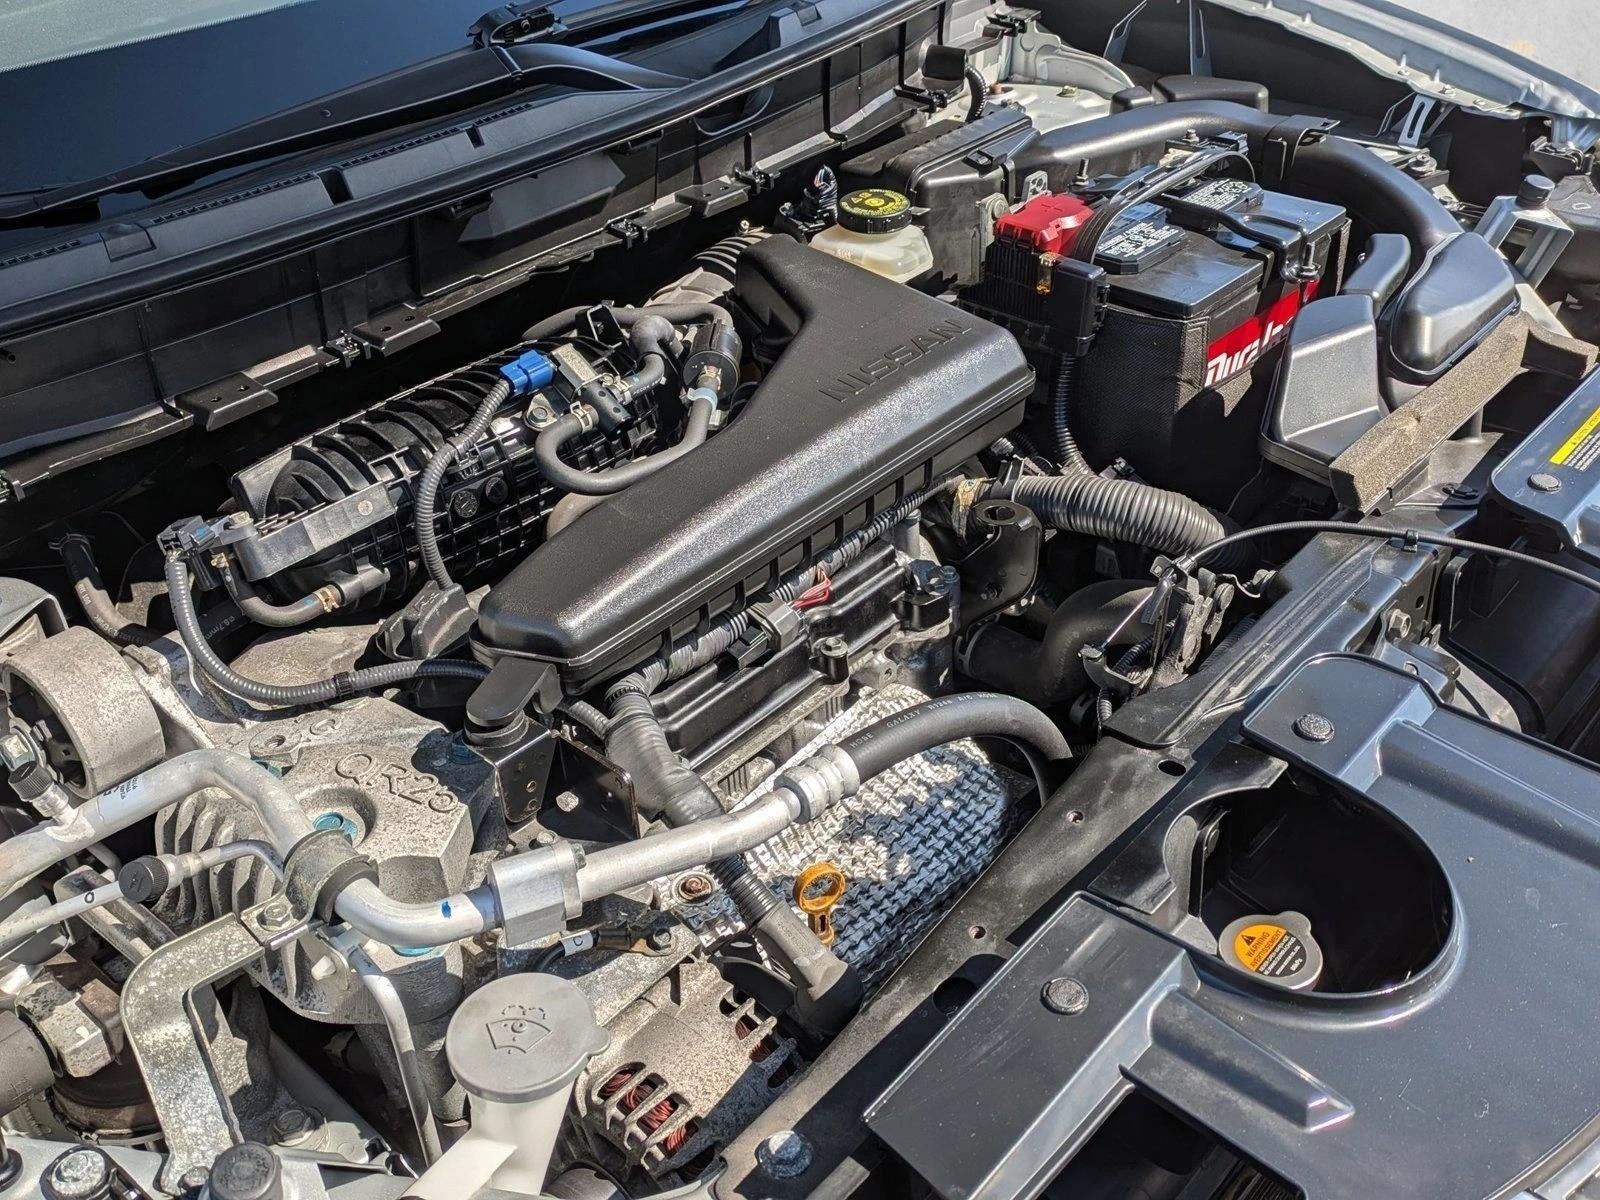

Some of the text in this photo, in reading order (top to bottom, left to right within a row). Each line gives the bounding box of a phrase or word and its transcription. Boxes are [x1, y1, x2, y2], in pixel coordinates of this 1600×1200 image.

[818, 320, 972, 402] NISSAN
[886, 709, 920, 728] GALAXY
[335, 752, 459, 813] QR25
[1246, 931, 1270, 958] WARNING
[1250, 929, 1283, 967] AVERTISSEMENT
